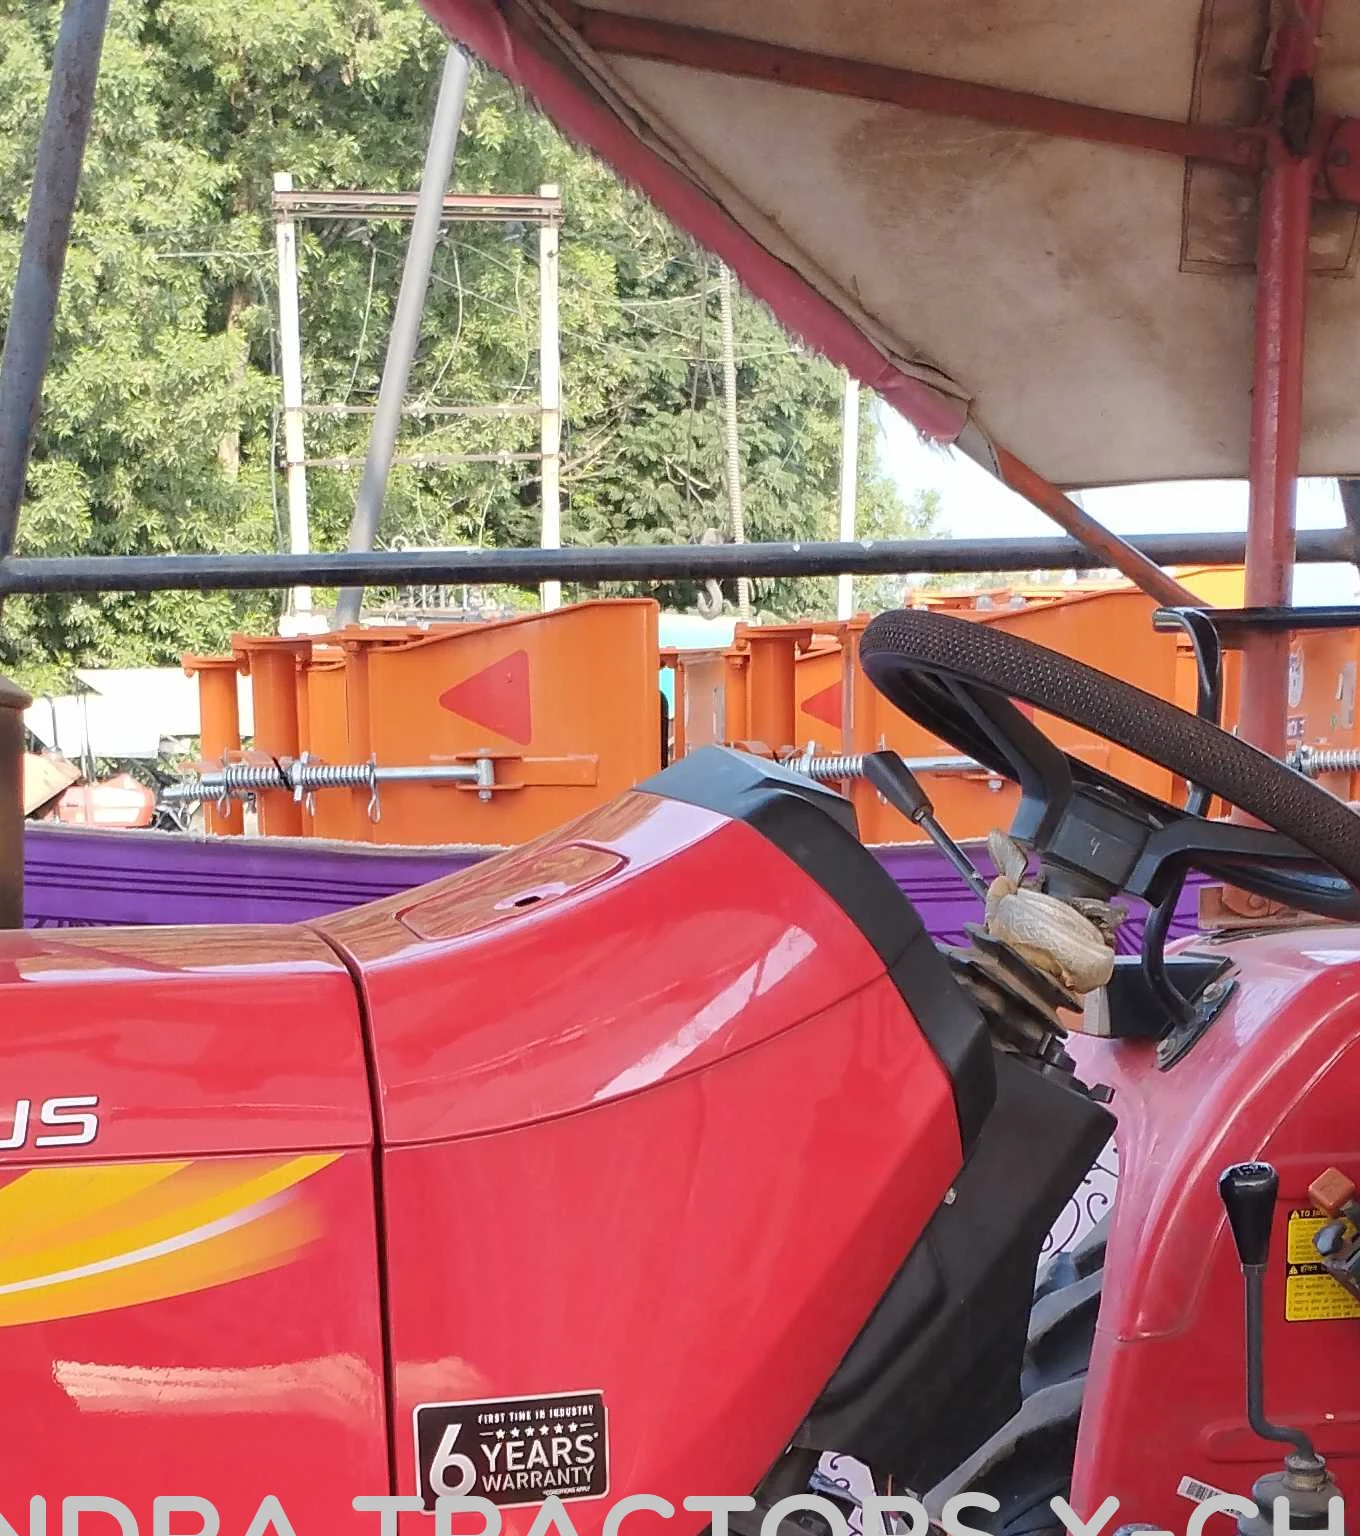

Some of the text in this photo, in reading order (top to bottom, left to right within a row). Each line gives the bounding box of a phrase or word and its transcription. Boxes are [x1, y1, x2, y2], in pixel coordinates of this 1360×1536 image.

[478, 1404, 595, 1425] FIRST TIME IN INDUSTRY
[429, 1423, 477, 1498] 6
[482, 1464, 595, 1493] WARRANTY
